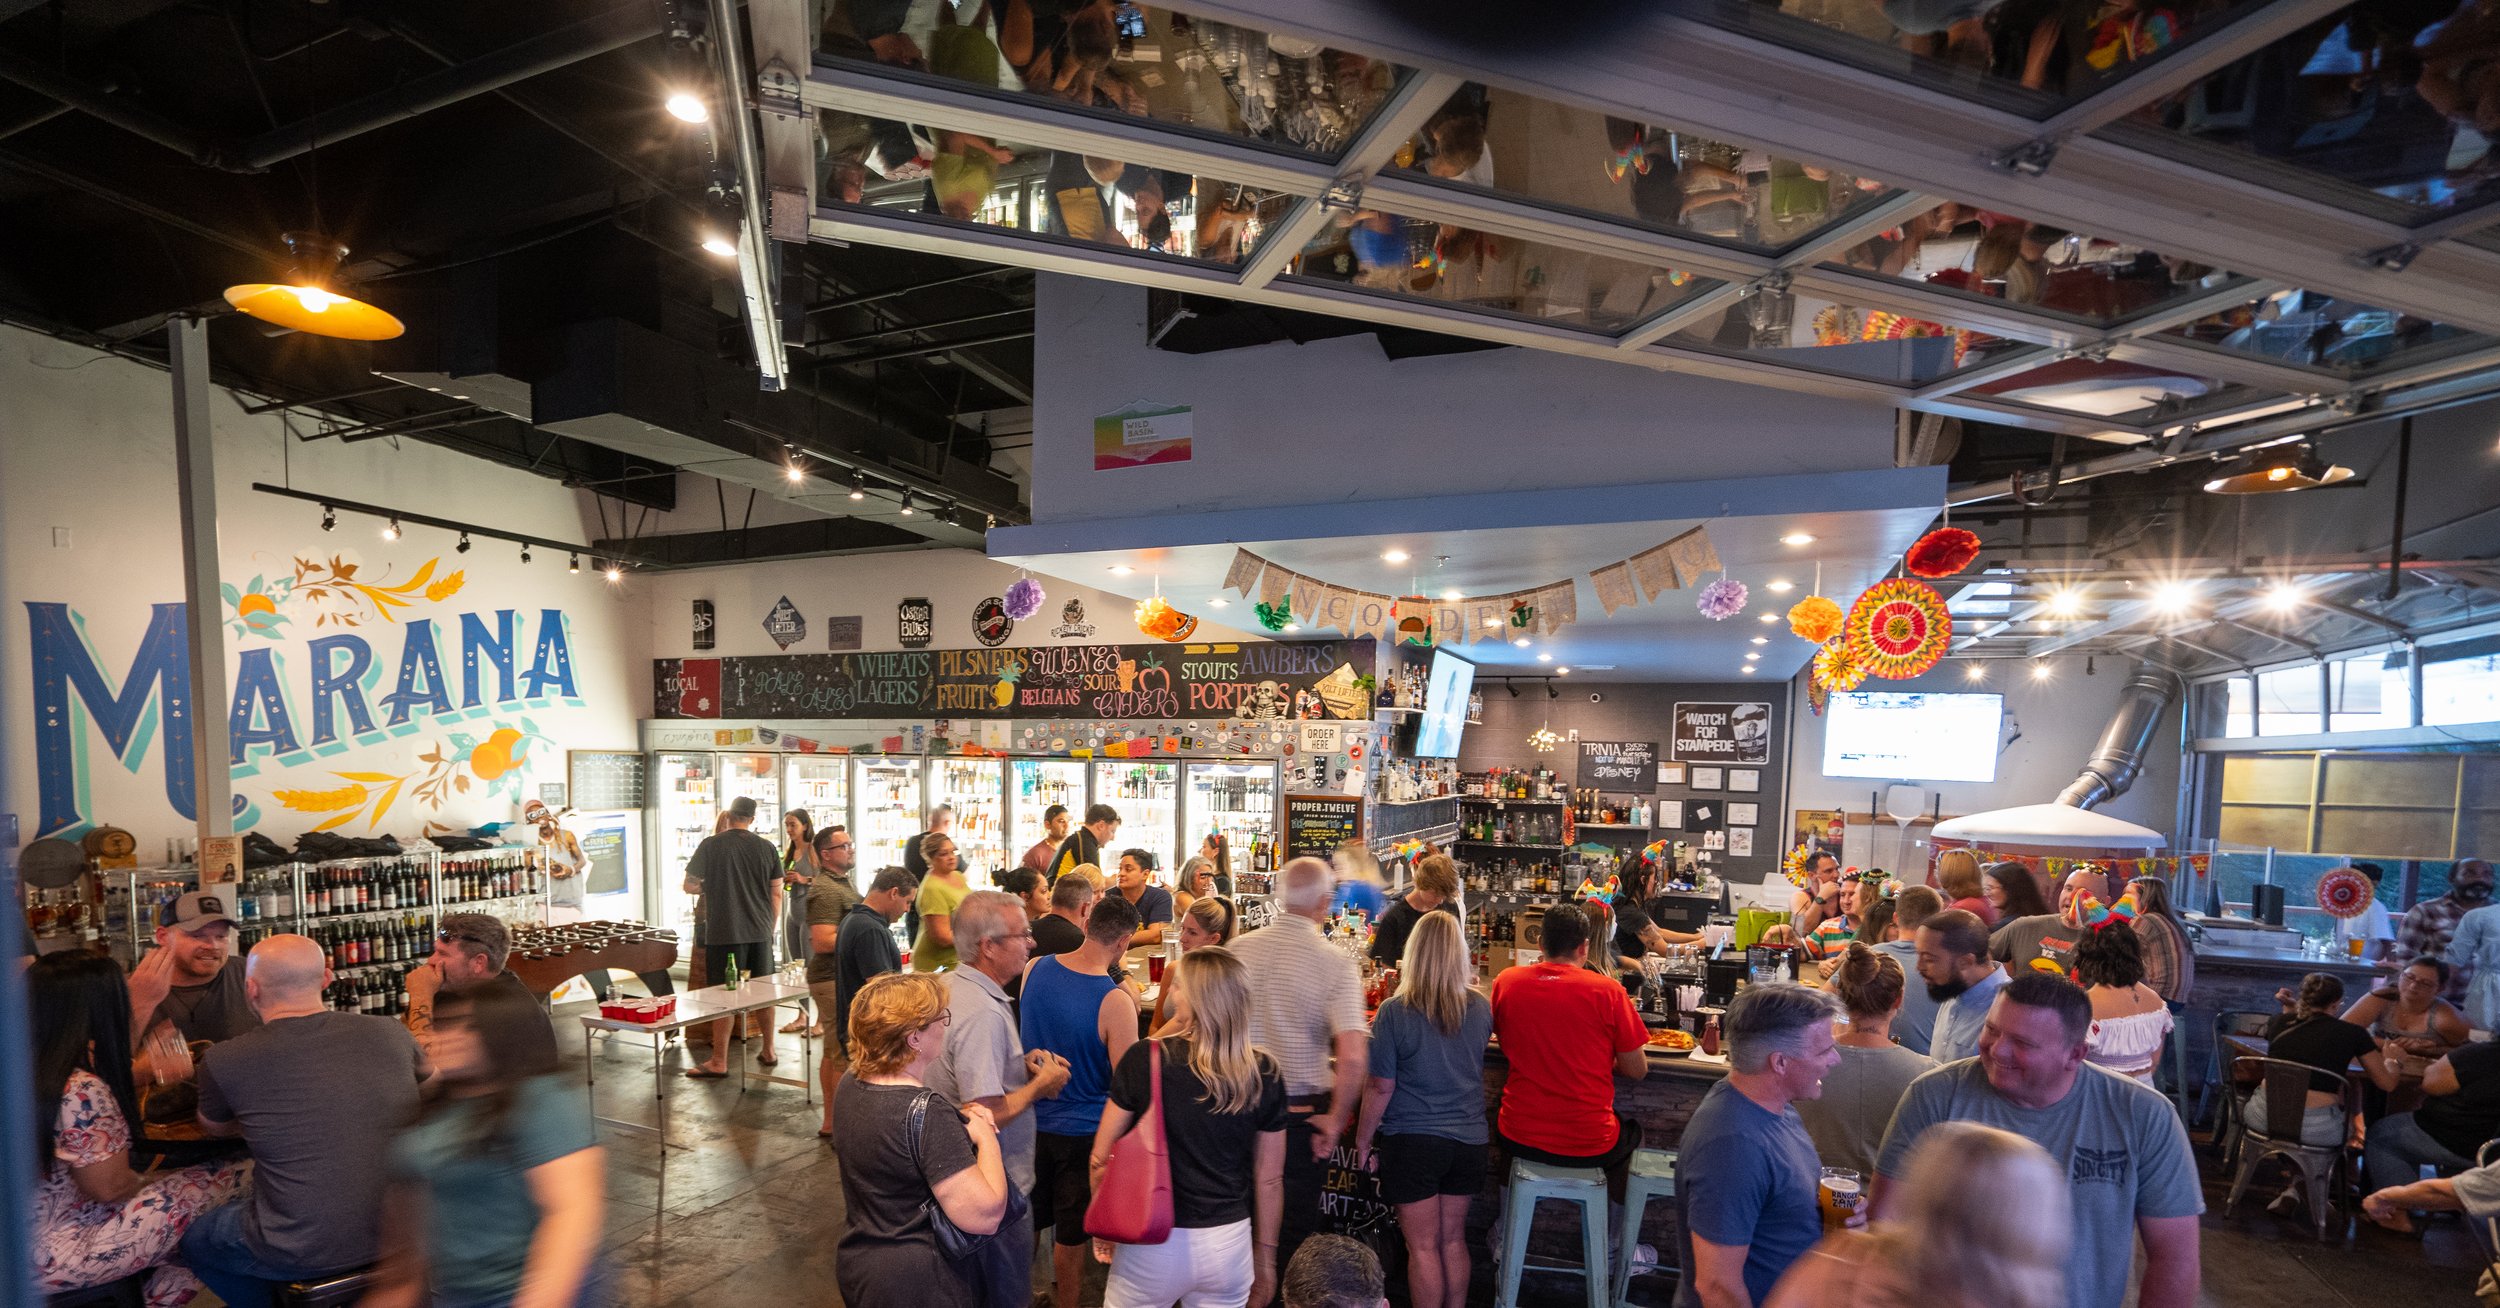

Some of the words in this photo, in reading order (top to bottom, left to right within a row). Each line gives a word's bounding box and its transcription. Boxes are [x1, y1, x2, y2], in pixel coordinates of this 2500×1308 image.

[1126, 420, 1149, 430] WILD
[1127, 428, 1154, 438] BASIN
[901, 605, 930, 621] OSKAR
[974, 599, 993, 621] FOUR
[901, 621, 929, 637] BLUES
[974, 628, 1010, 646] BREWING
[1074, 624, 1096, 637] CRICKET
[857, 652, 931, 678] WHEATS
[939, 648, 1029, 677] PILSNERS
[1032, 645, 1122, 675] WINES
[1239, 645, 1335, 675] AMBERS
[1181, 662, 1239, 680] STOUTS
[667, 676, 699, 692] LOCAL
[736, 663, 746, 706] IPA
[754, 671, 805, 695] PALE
[1321, 683, 1337, 694] KILT
[800, 686, 857, 712] ALES
[856, 680, 919, 705] LAGERS
[936, 684, 999, 711] FRUITS
[1021, 688, 1081, 706] BELGIANS
[1189, 682, 1291, 710] PORTES
[1093, 687, 1180, 718] CIDERS
[22, 602, 580, 838] MARANA
[1686, 712, 1727, 726] WATCH
[1307, 728, 1335, 739] ORDER
[1695, 726, 1718, 739] FOR
[1311, 740, 1329, 750] HERE
[1581, 742, 1622, 756] TRIVIA
[1676, 738, 1735, 752] STAMPEDE
[590, 754, 615, 763] MAY
[1291, 801, 1322, 812] PROPER
[1324, 803, 1357, 813] TWELVE
[1250, 907, 1262, 921] 25
[2073, 1154, 2096, 1181] SIN
[2097, 1160, 2128, 1184] CITY
